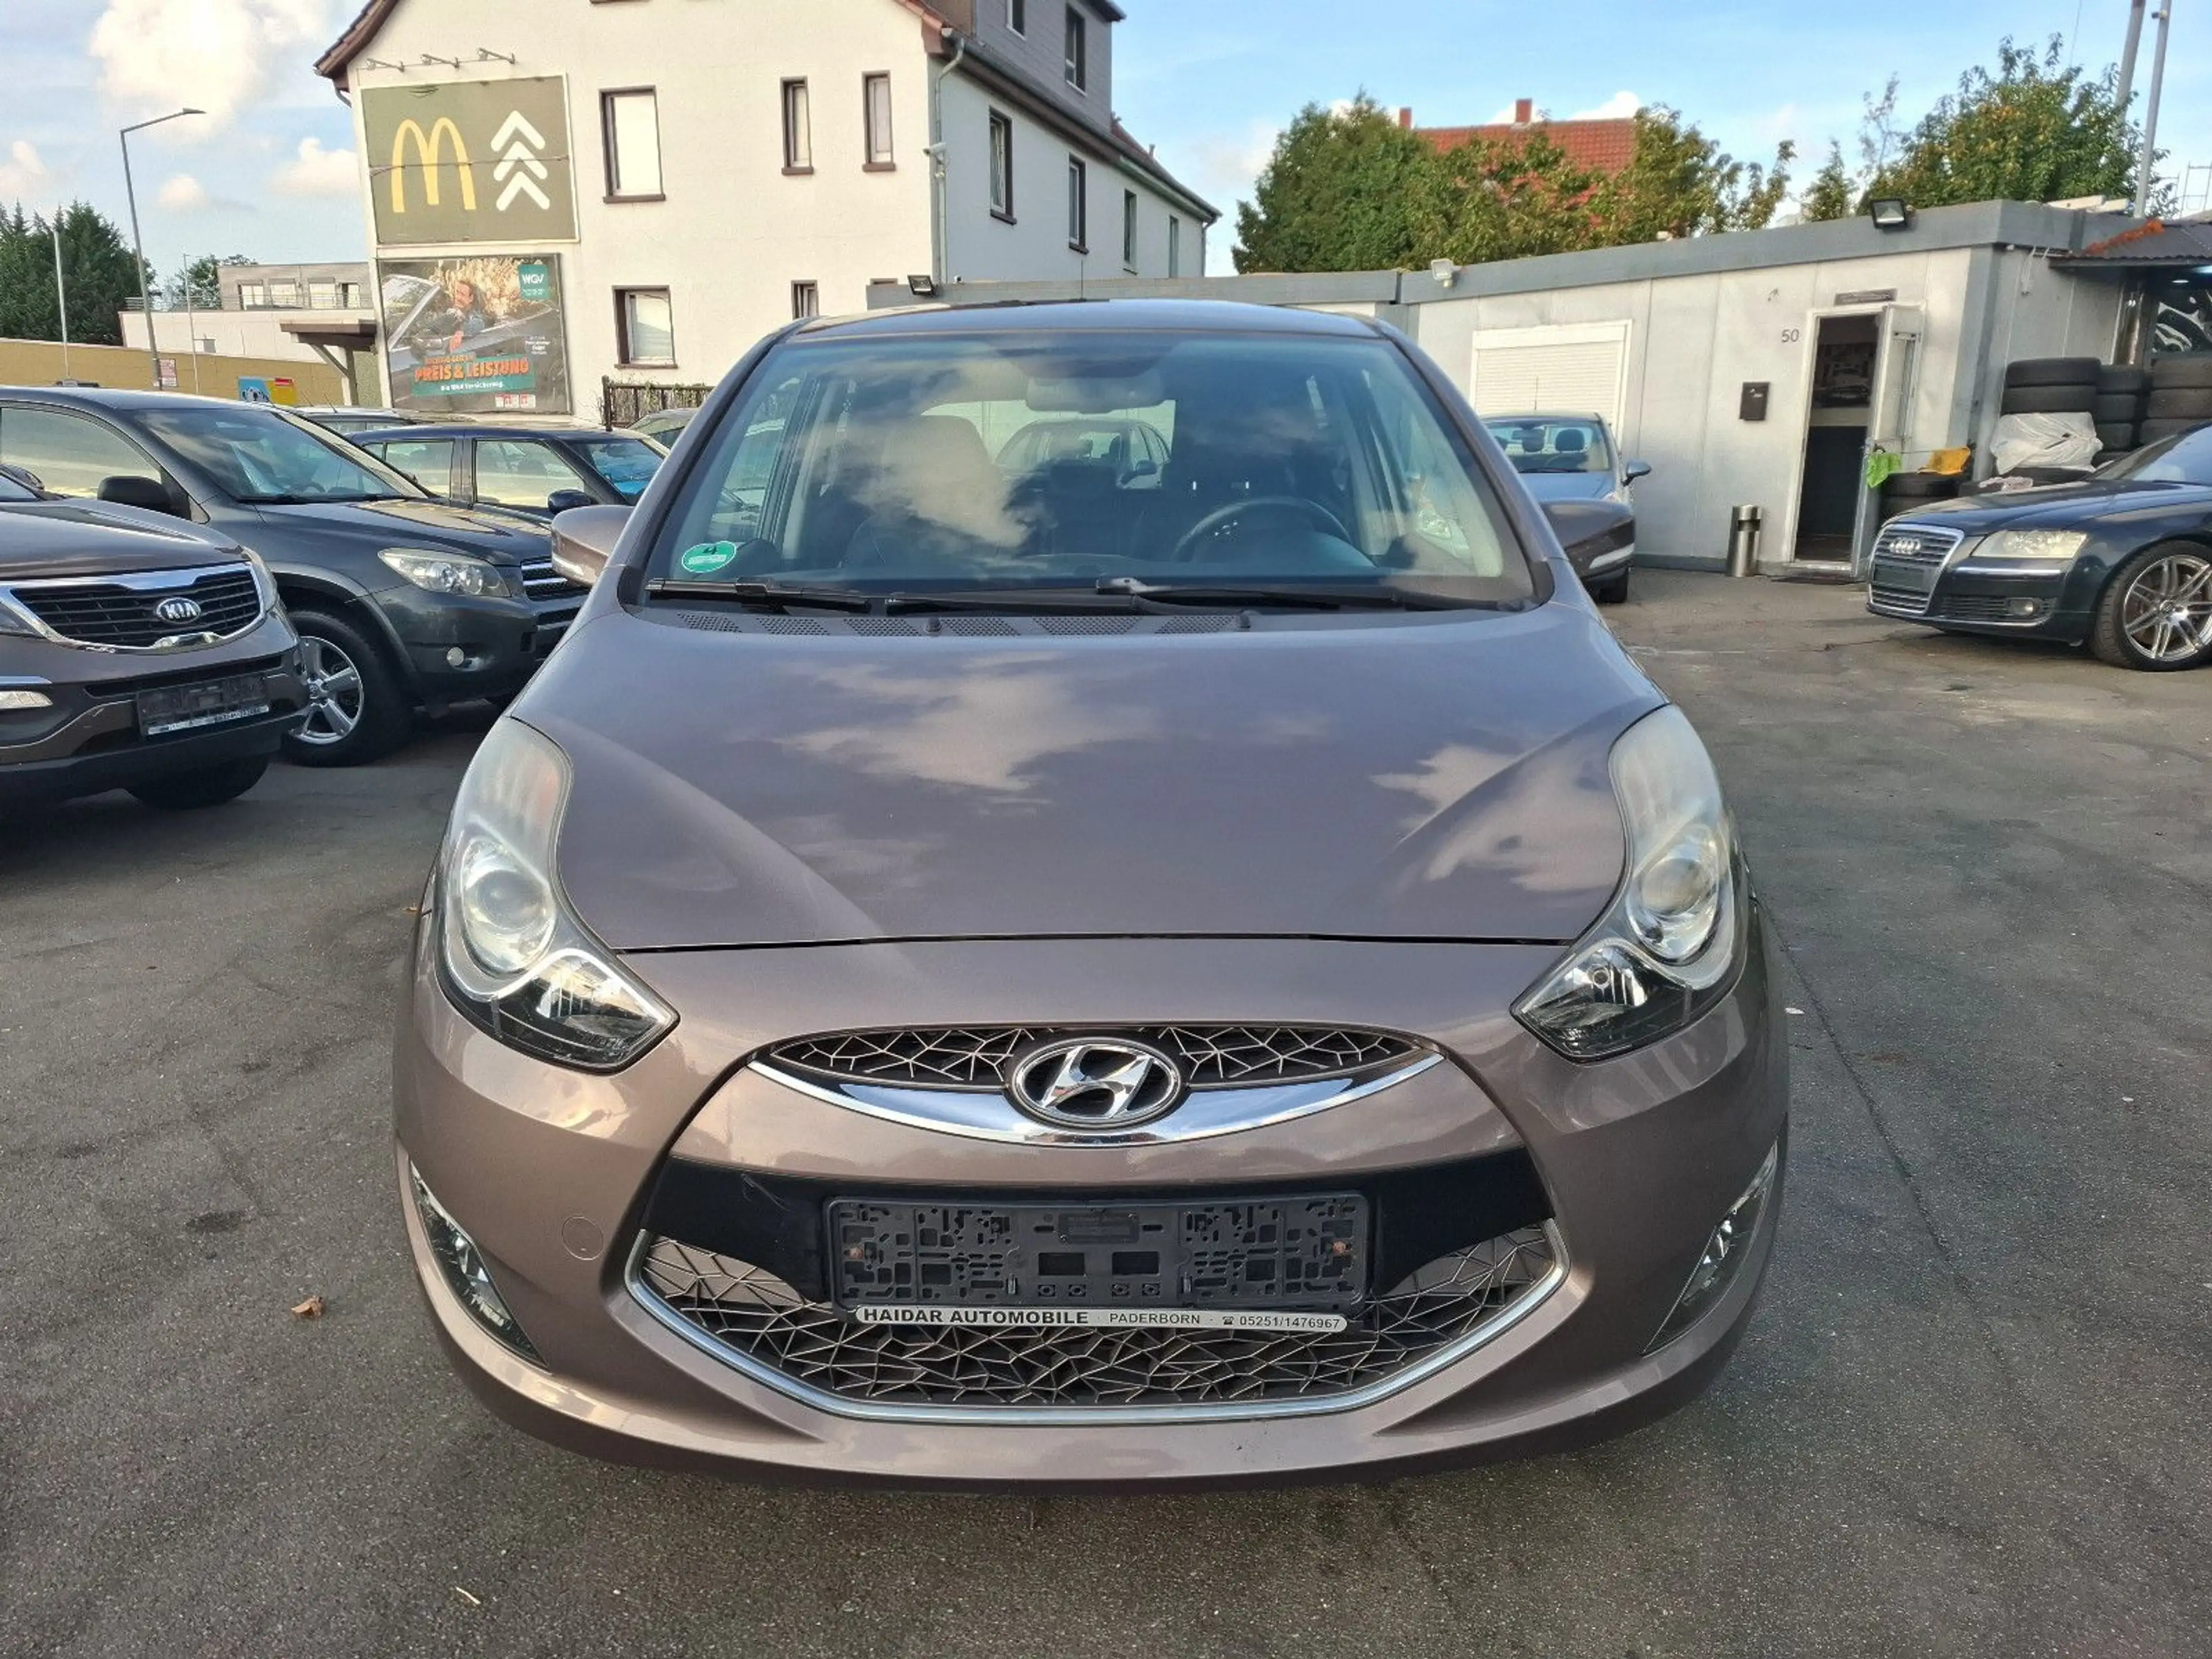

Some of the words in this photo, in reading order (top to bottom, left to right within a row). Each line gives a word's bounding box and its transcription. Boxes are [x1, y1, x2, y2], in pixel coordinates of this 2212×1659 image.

[1782, 329, 1800, 342] 50
[414, 364, 452, 382] PREIS
[453, 365, 464, 378] &
[466, 357, 529, 378] LEISTUNG
[702, 547, 718, 555] 4
[164, 603, 197, 619] KIA
[864, 1308, 944, 1323] HAIDAR
[950, 1310, 1089, 1324] AUTOMOBILE
[1109, 1313, 1200, 1324] PADERBORN
[1240, 1316, 1341, 1328] 05251/1476967
